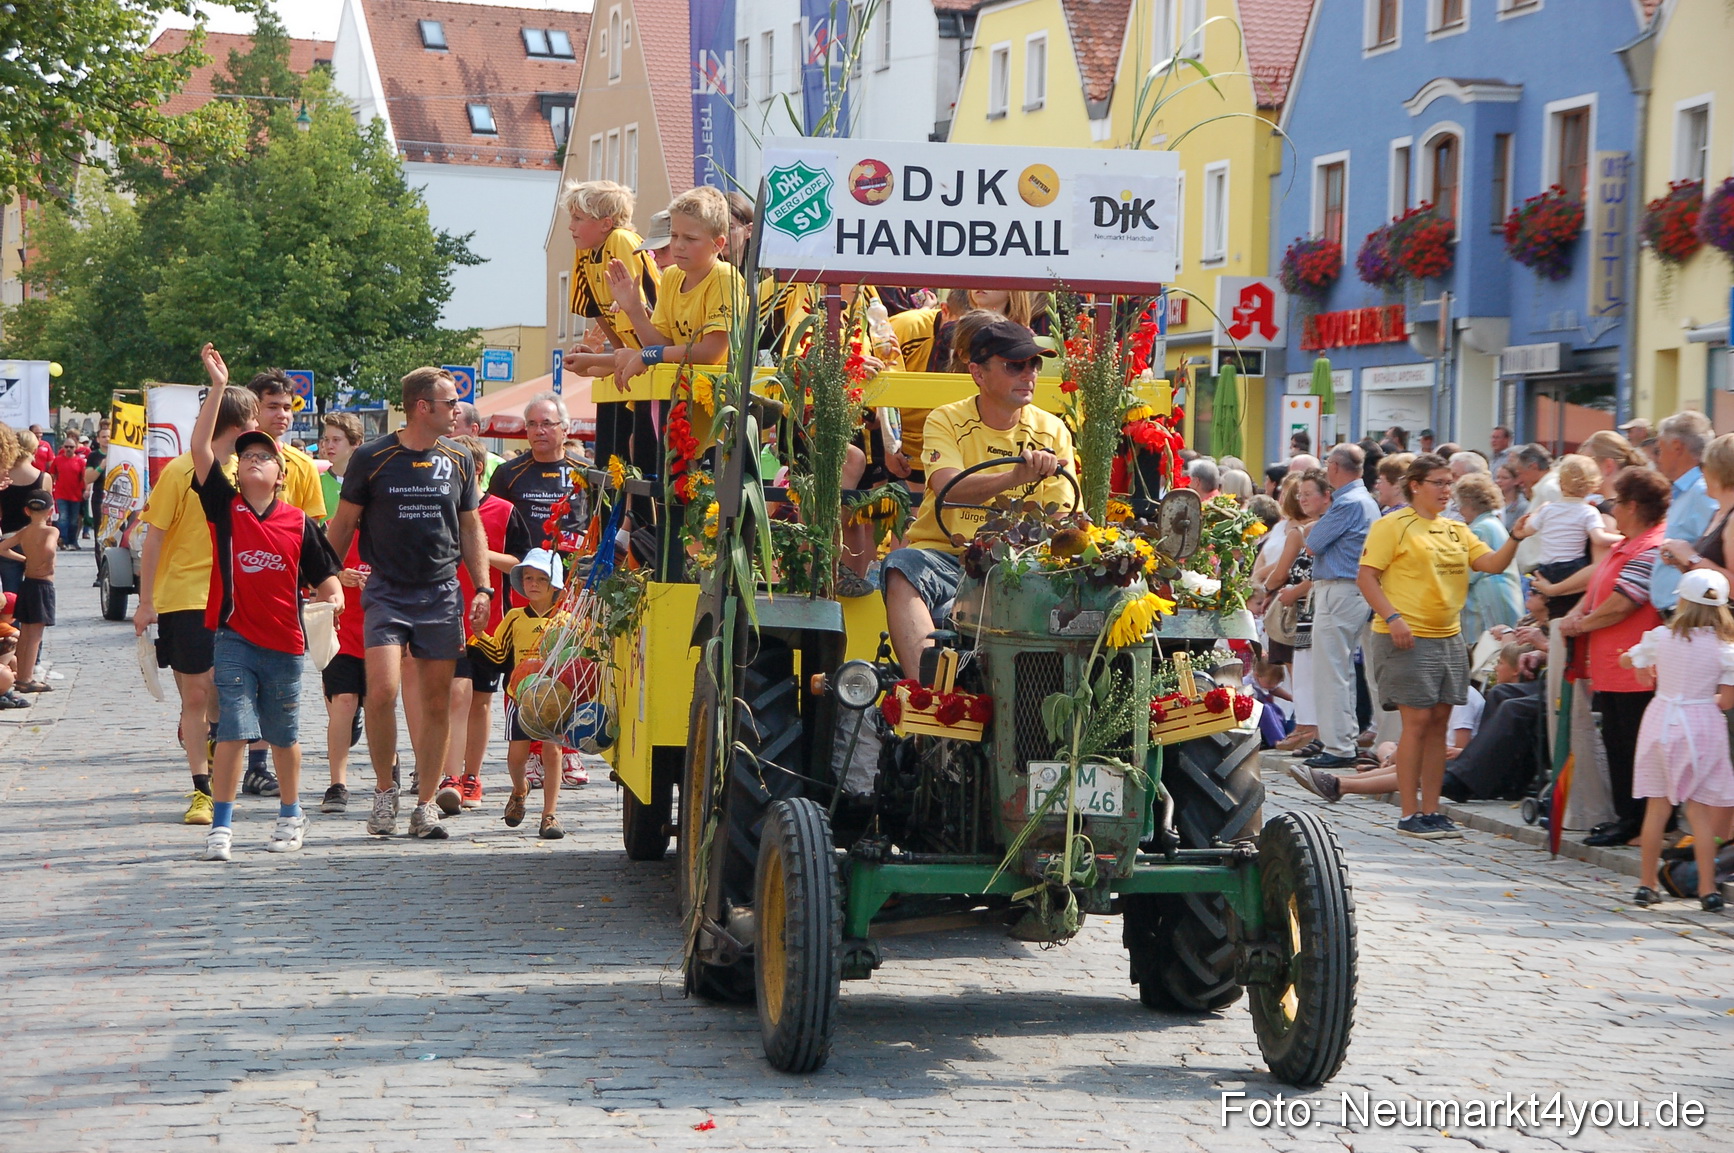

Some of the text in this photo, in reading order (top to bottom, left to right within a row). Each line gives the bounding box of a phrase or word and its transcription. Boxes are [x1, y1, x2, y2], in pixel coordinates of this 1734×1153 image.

[774, 196, 801, 218] BERG
[804, 178, 826, 196] OPF.
[793, 200, 822, 231] SV
[836, 218, 1070, 257] HANDBALL
[1094, 233, 1155, 242] Neumarkt Handball
[1299, 303, 1408, 351] APOTHEKE
[554, 353, 561, 380] P
[987, 445, 1013, 457] Kempa
[431, 455, 453, 480] 29
[389, 486, 438, 494] HanseMerkur
[398, 511, 442, 520] Jürgen Seidel
[960, 511, 990, 523] Jürge
[243, 554, 287, 572] TOUCH
[253, 550, 283, 563] PRO
[1088, 790, 1116, 813] 46
